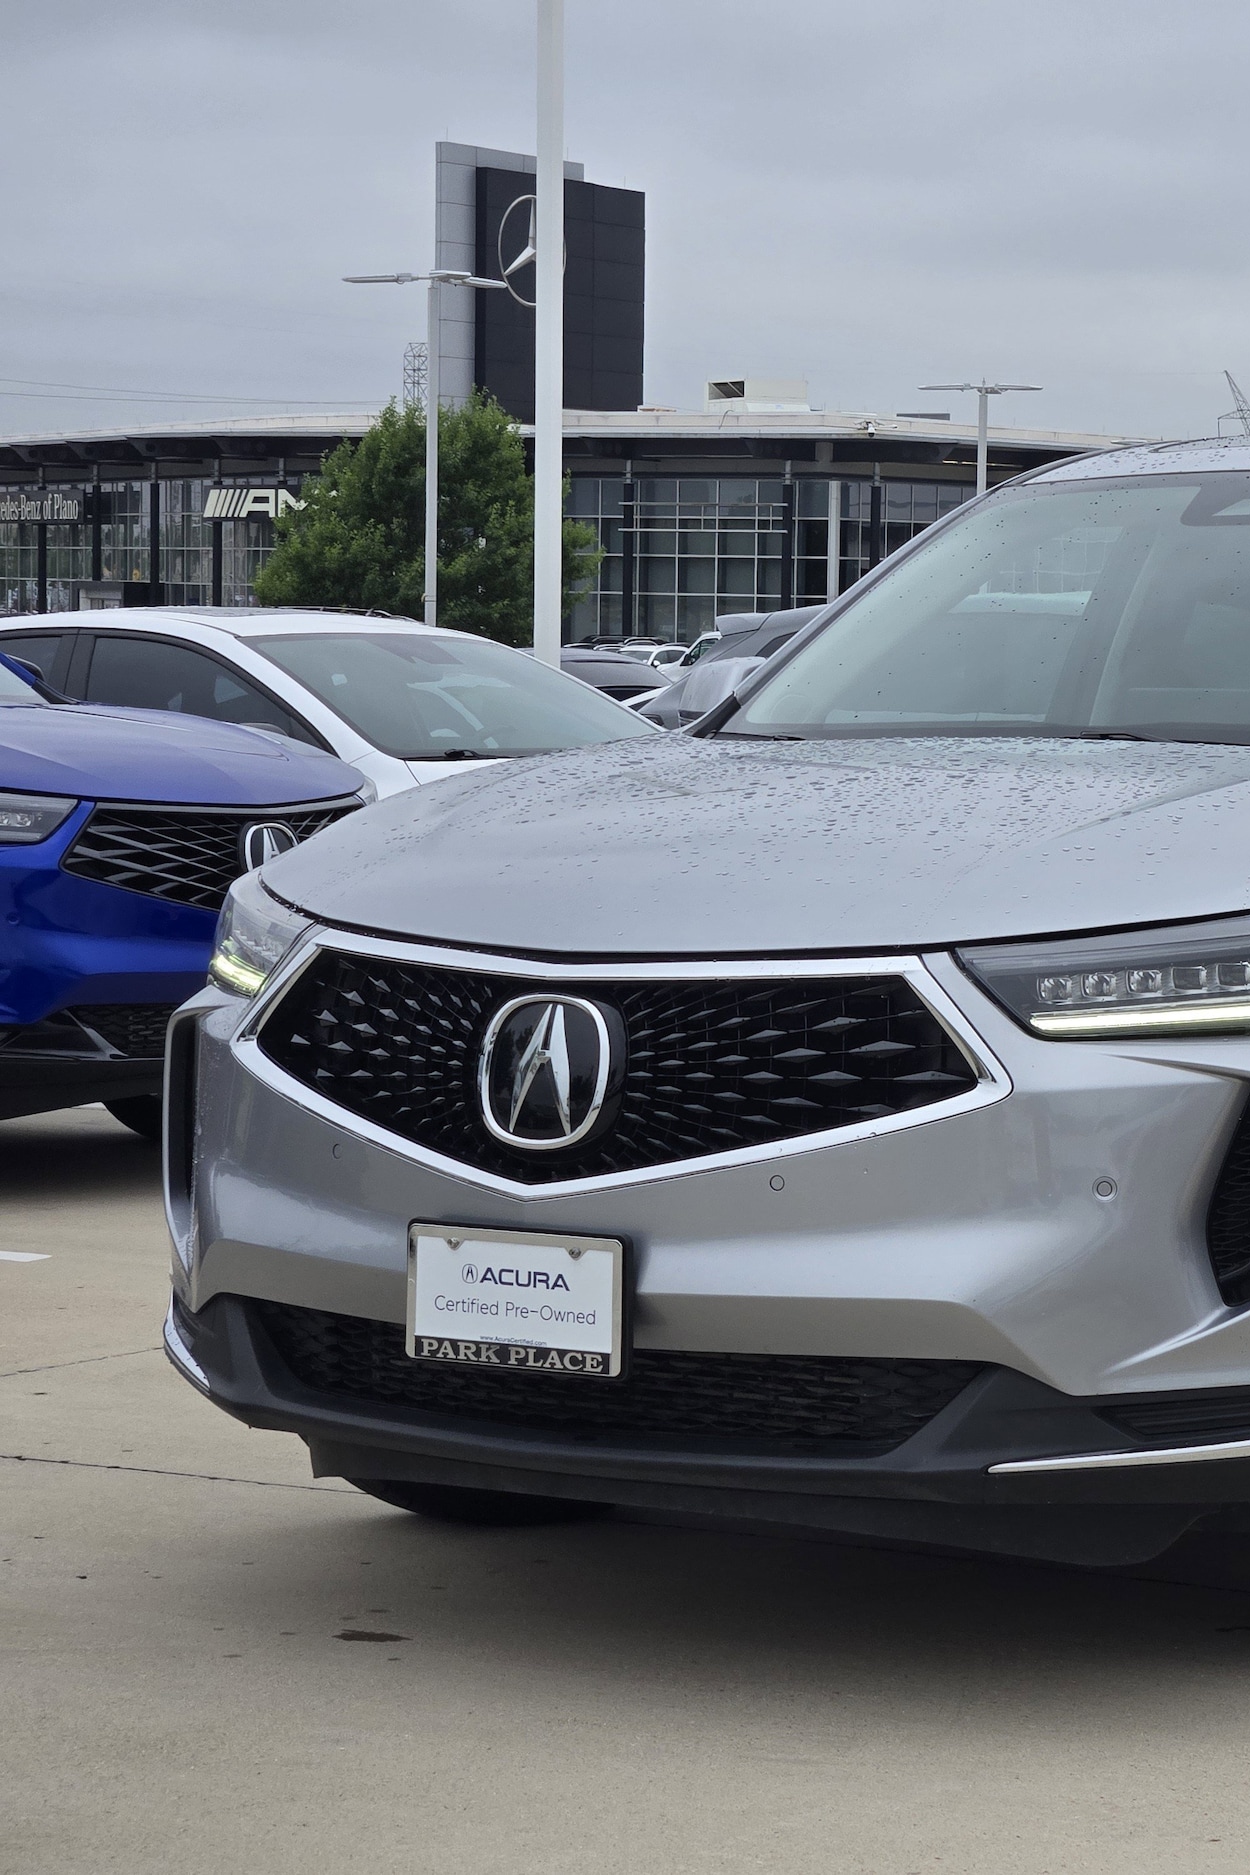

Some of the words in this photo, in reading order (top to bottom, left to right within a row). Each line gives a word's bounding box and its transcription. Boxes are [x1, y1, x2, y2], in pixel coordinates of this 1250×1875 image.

[43, 493, 53, 520] of
[53, 493, 79, 520] Plano
[479, 1267, 570, 1291] ACURA
[434, 1295, 499, 1316] Certified
[505, 1301, 597, 1325] Pre-Owned
[480, 1336, 547, 1346] www.AcuraCertified.com
[420, 1338, 501, 1363] PARK
[507, 1347, 603, 1373] PLACE
